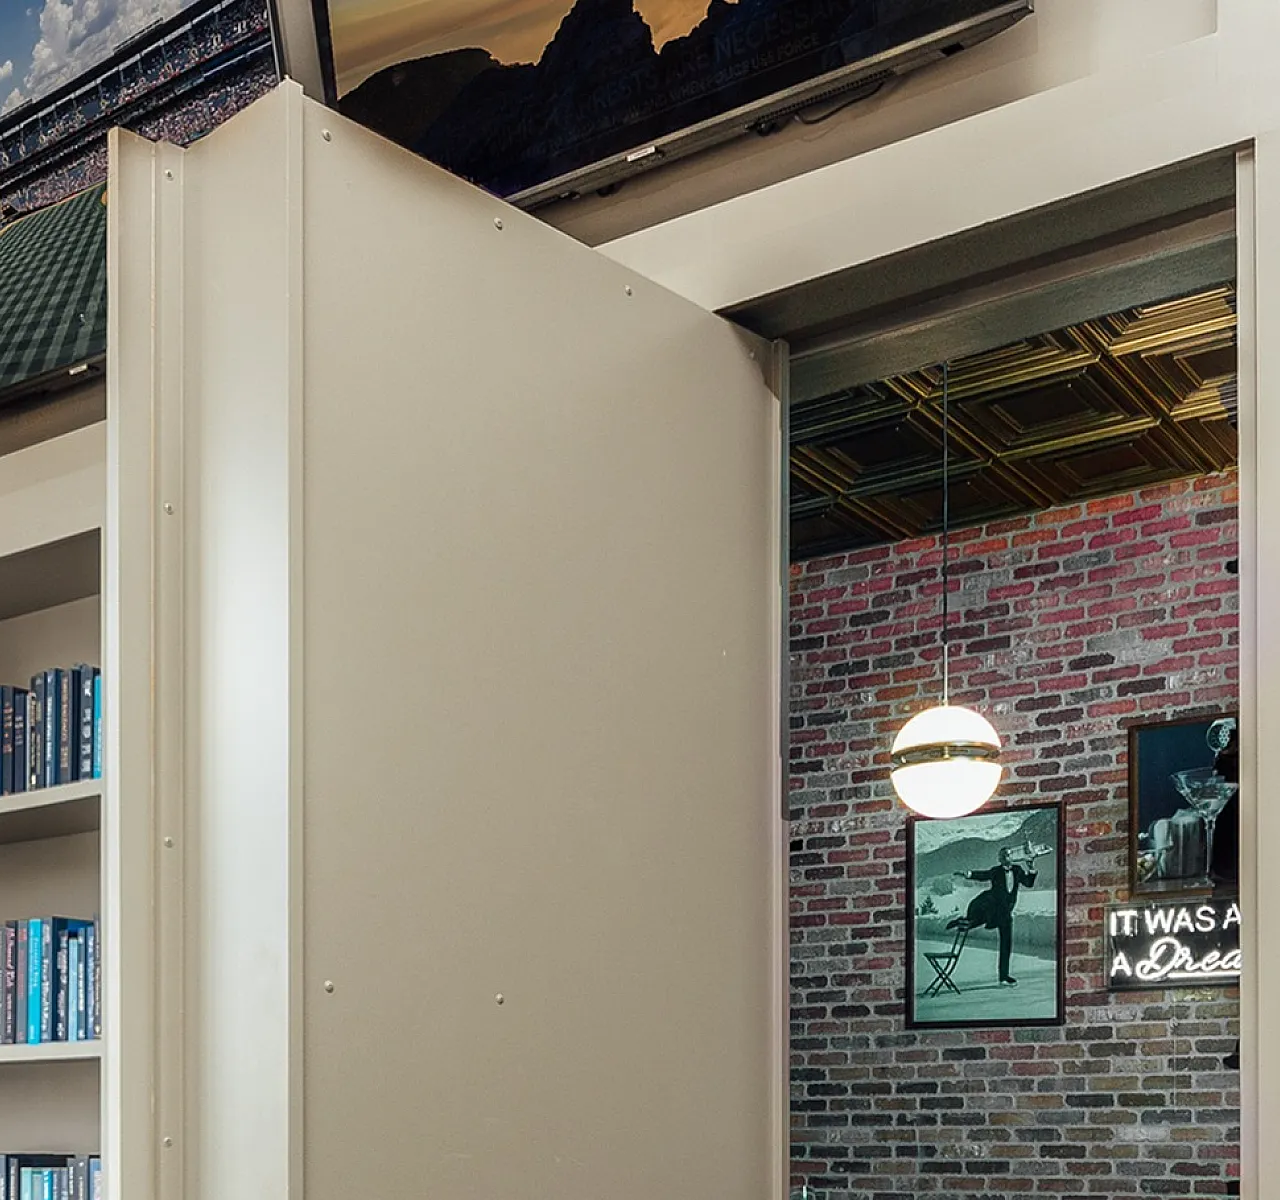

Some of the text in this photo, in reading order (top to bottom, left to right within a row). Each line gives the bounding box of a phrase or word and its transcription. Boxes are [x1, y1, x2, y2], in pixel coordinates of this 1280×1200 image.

[1110, 910, 1138, 937] IT
[1145, 906, 1214, 935] WAS
[1110, 936, 1242, 981] A Drea
